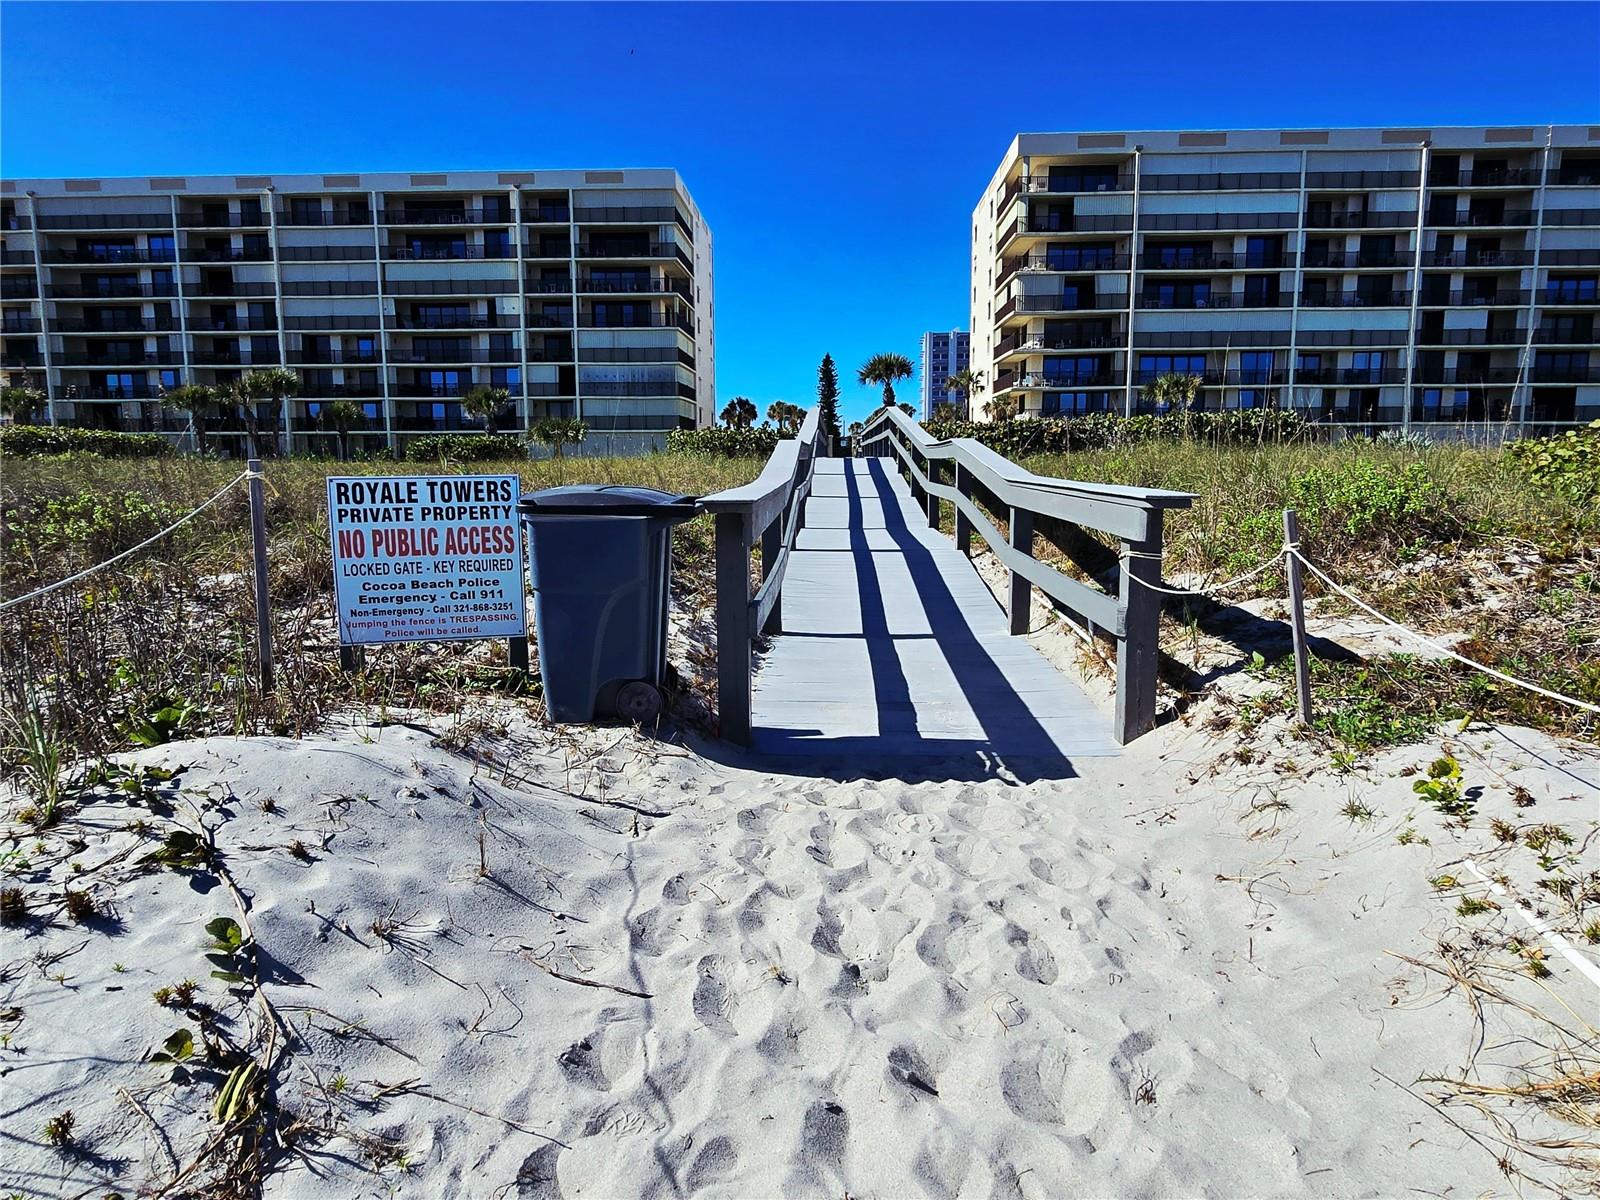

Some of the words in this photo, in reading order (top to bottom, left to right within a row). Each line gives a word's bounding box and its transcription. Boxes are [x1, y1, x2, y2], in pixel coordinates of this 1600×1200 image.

[336, 482, 418, 505] ROYALE
[426, 480, 512, 503] TOWERS
[338, 507, 414, 523] PRIVATE
[421, 506, 512, 521] PROPERTY
[338, 529, 365, 558] NO
[372, 527, 438, 557] PUBLIC
[445, 526, 514, 555] ACCESS
[344, 563, 390, 576] LOCKED
[394, 562, 423, 574] GATE
[434, 561, 455, 573] KEY
[459, 559, 513, 572] REQUIRED
[362, 582, 406, 591] Cocoa
[411, 580, 453, 589] Beach
[459, 578, 500, 587] Police
[359, 593, 436, 604] Emergency
[450, 591, 475, 600] Call
[481, 590, 503, 598] 911
[350, 607, 424, 618] Non-Emergency
[453, 603, 513, 612] 321-868-3251
[347, 619, 388, 629] Jumping
[450, 614, 518, 623] TRESPASSING.
